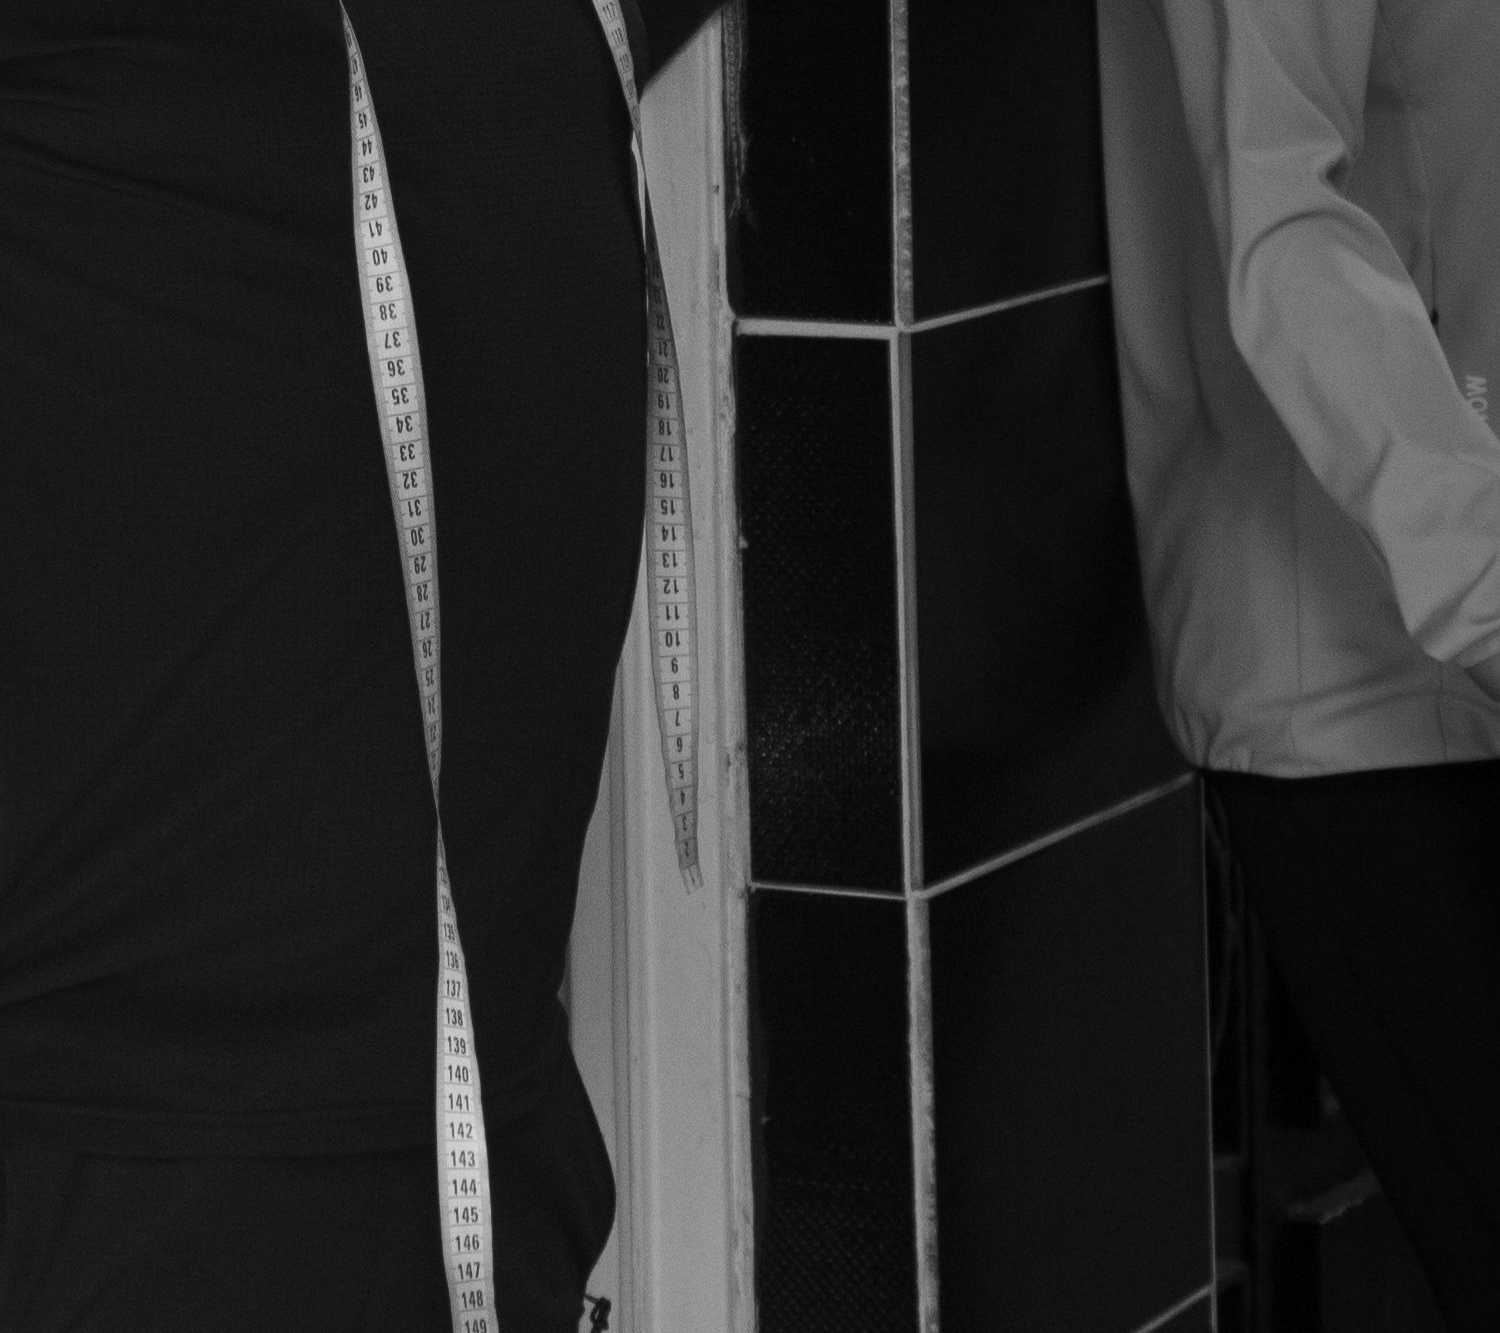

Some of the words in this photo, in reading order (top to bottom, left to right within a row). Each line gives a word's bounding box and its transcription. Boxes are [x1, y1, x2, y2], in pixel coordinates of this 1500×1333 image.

[358, 112, 367, 129] 45
[362, 139, 372, 156] 44
[363, 166, 375, 183] 43
[365, 193, 378, 211] 42
[368, 221, 382, 238] 41
[372, 248, 388, 266] 40
[376, 275, 393, 293] 39
[379, 303, 397, 321] 38
[384, 331, 401, 349] 37
[387, 359, 405, 377] 36
[657, 367, 669, 383] 20
[391, 387, 409, 405] 35
[658, 392, 670, 410] 19
[396, 415, 413, 434] 34
[658, 418, 672, 436] 18
[400, 443, 415, 462] 33
[660, 445, 674, 462] 17
[402, 471, 418, 490] 32
[660, 472, 675, 489] 16
[408, 499, 421, 517] 31
[660, 499, 675, 516] 15
[411, 526, 424, 547] 30
[661, 525, 677, 542] 14
[414, 554, 426, 574] 29
[662, 552, 678, 568] 13
[416, 583, 428, 603] 28
[663, 579, 679, 594] 12
[420, 611, 431, 631] 27
[666, 605, 680, 621] 11
[665, 631, 681, 647] 10
[422, 639, 433, 659] 26
[671, 657, 678, 674] 9
[673, 683, 679, 700] 8
[675, 710, 681, 727] 7
[676, 736, 683, 753] 6
[678, 763, 684, 779] 5
[446, 950, 459, 971] 136
[446, 979, 461, 998] 137
[446, 1007, 463, 1027] 138
[447, 1036, 466, 1055] 139
[448, 1065, 469, 1083] 140
[448, 1093, 469, 1111] 141
[450, 1122, 472, 1138] 142
[451, 1150, 475, 1167] 143
[452, 1179, 477, 1196] 144
[454, 1207, 478, 1224] 145
[455, 1234, 480, 1252] 146
[458, 1261, 480, 1280] 147
[462, 1290, 483, 1309] 148
[464, 1318, 487, 1333] 149
